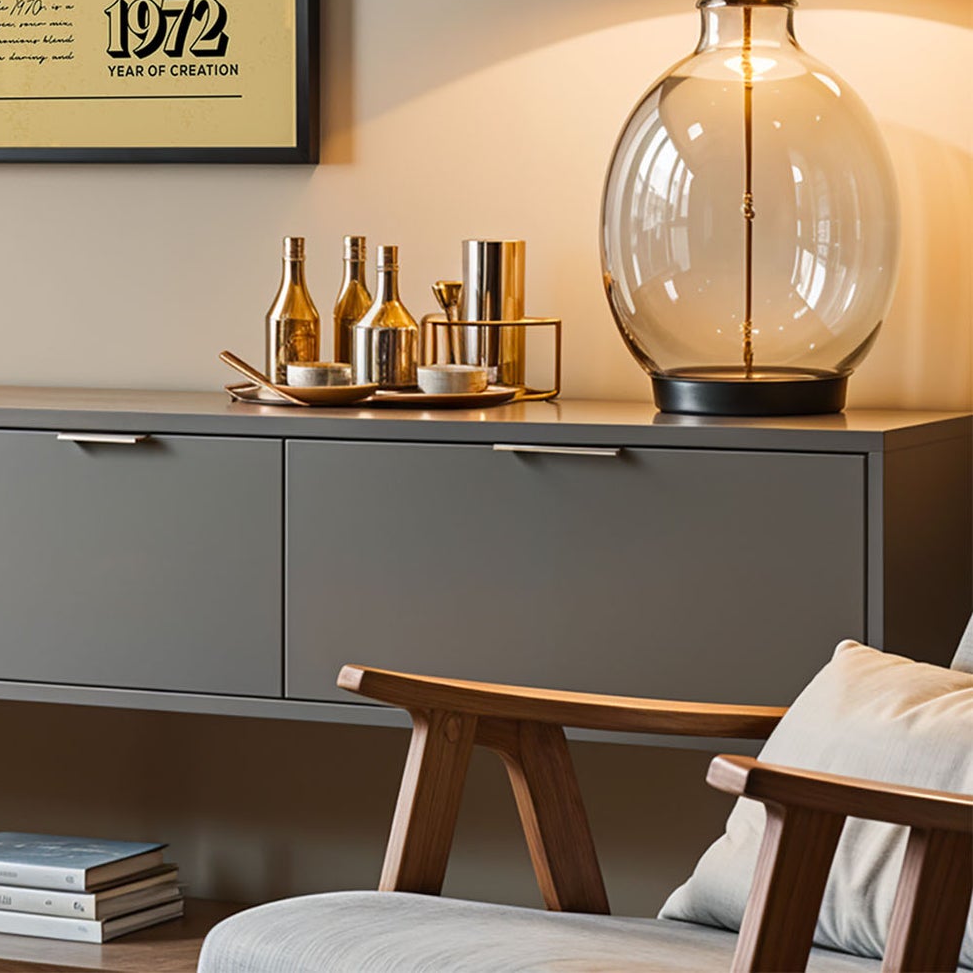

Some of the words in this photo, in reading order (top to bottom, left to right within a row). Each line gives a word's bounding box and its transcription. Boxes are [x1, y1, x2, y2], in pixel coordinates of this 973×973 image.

[108, 65, 144, 77] YEAR
[147, 65, 165, 76] OF
[170, 64, 239, 76] CREATION
